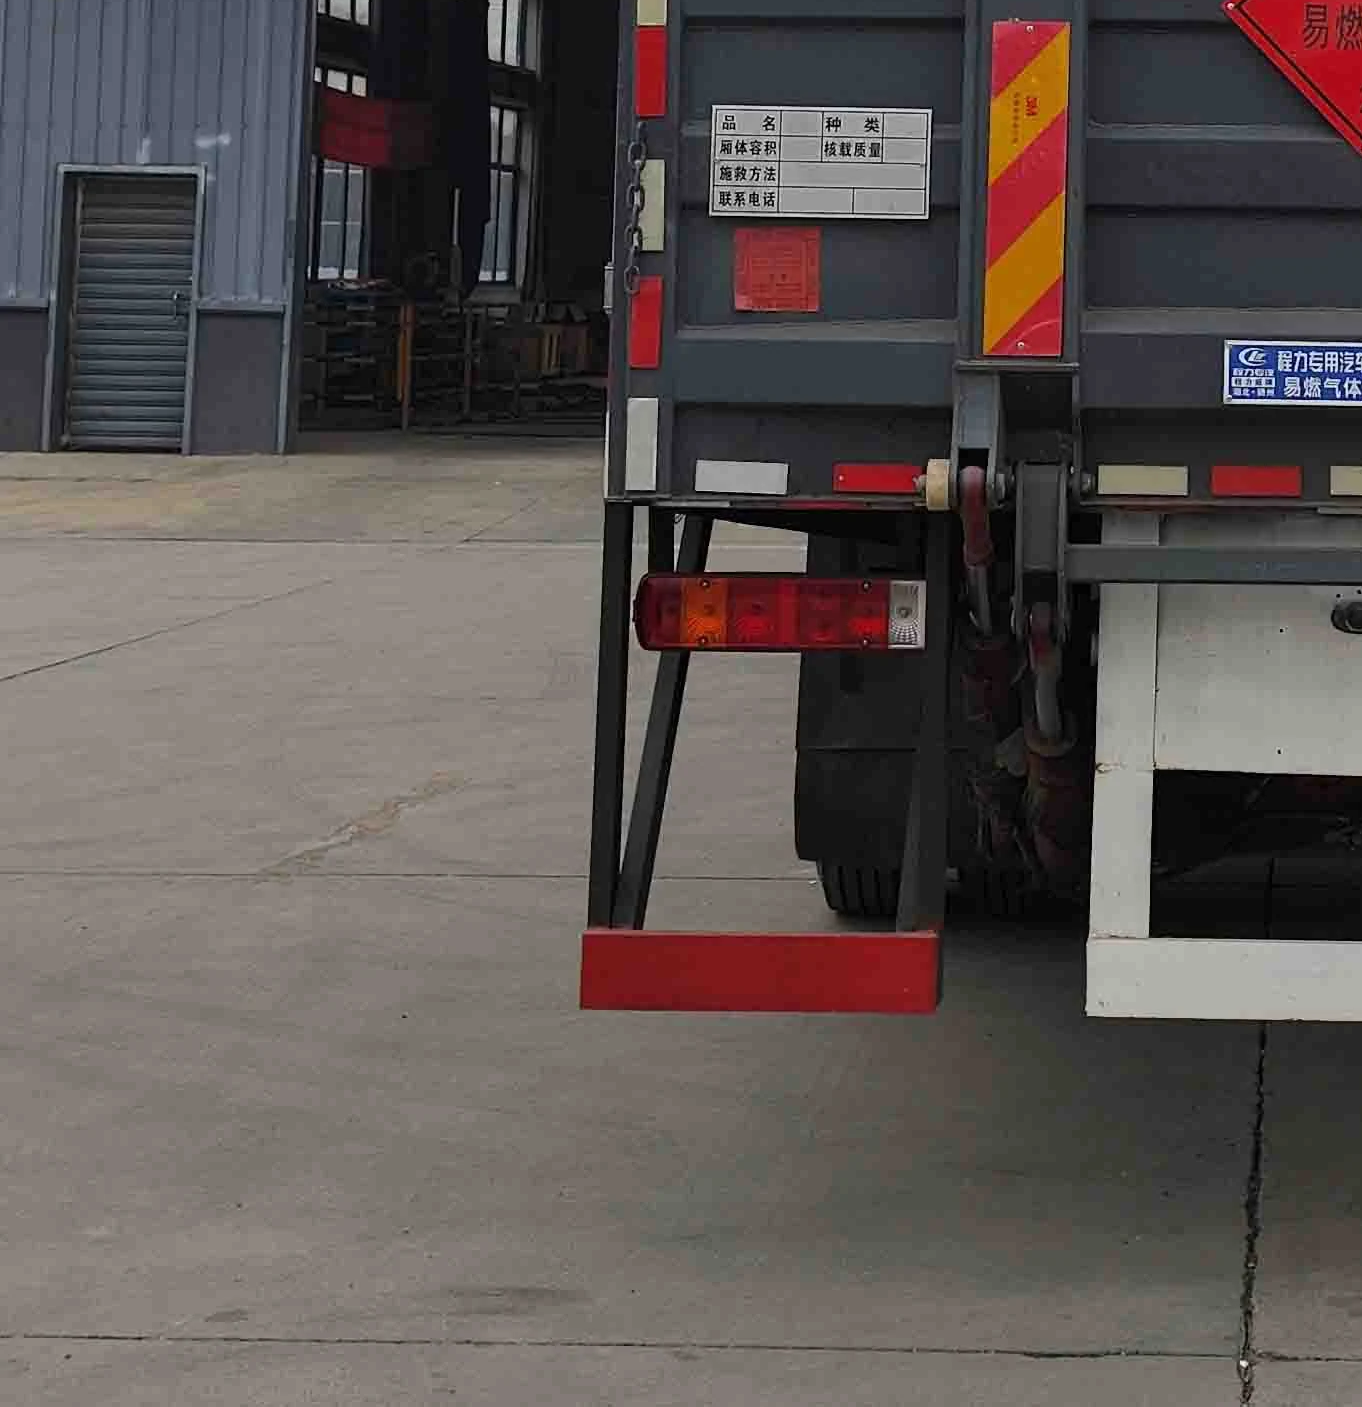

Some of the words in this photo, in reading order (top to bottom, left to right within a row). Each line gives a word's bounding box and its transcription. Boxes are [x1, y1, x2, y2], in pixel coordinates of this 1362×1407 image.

[719, 139, 777, 156] 厢体容积
[824, 141, 881, 158] 核载质量
[719, 166, 776, 182] 施救方法
[718, 191, 776, 208] 联系电话
